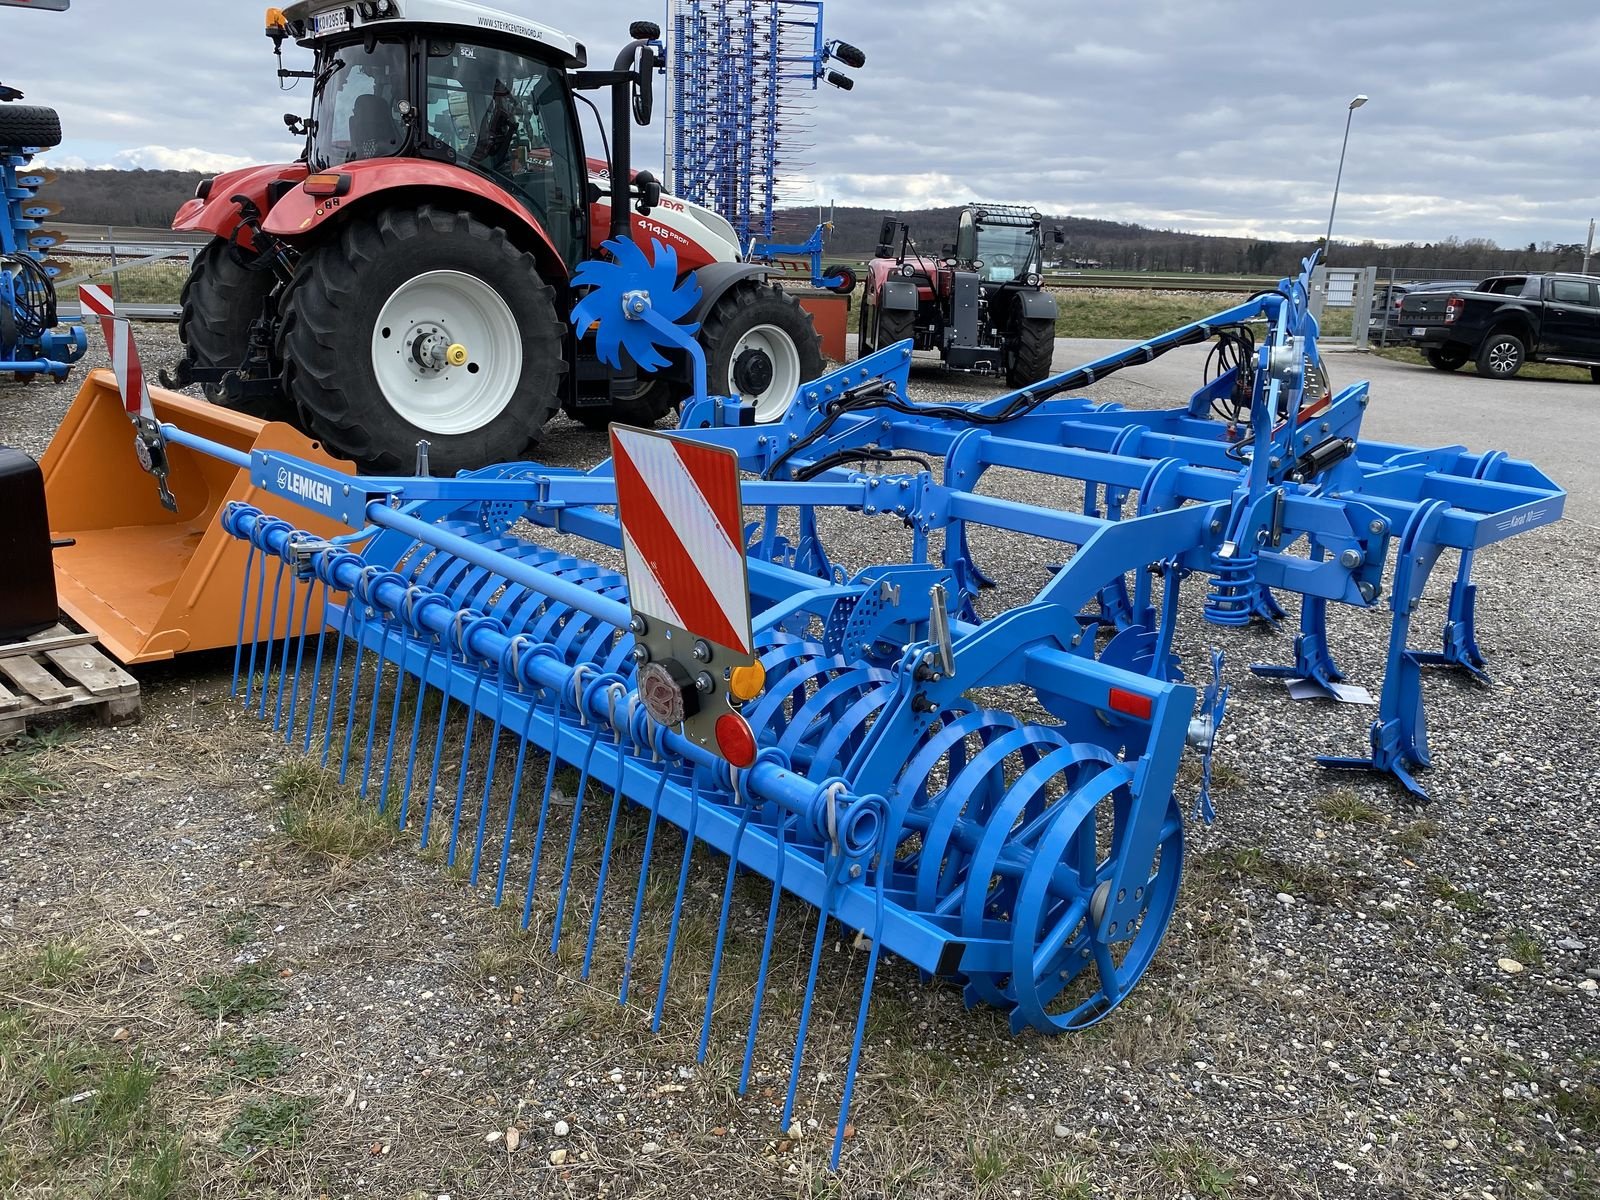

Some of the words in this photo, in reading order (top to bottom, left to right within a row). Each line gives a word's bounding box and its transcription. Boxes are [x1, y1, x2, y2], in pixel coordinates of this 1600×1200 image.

[477, 16, 543, 40] WWW.STEYRCENTERNORD.AT
[659, 198, 685, 213] TEYR
[638, 220, 669, 239] 4145
[669, 232, 690, 246] PROFI
[287, 470, 332, 507] LEMKEN
